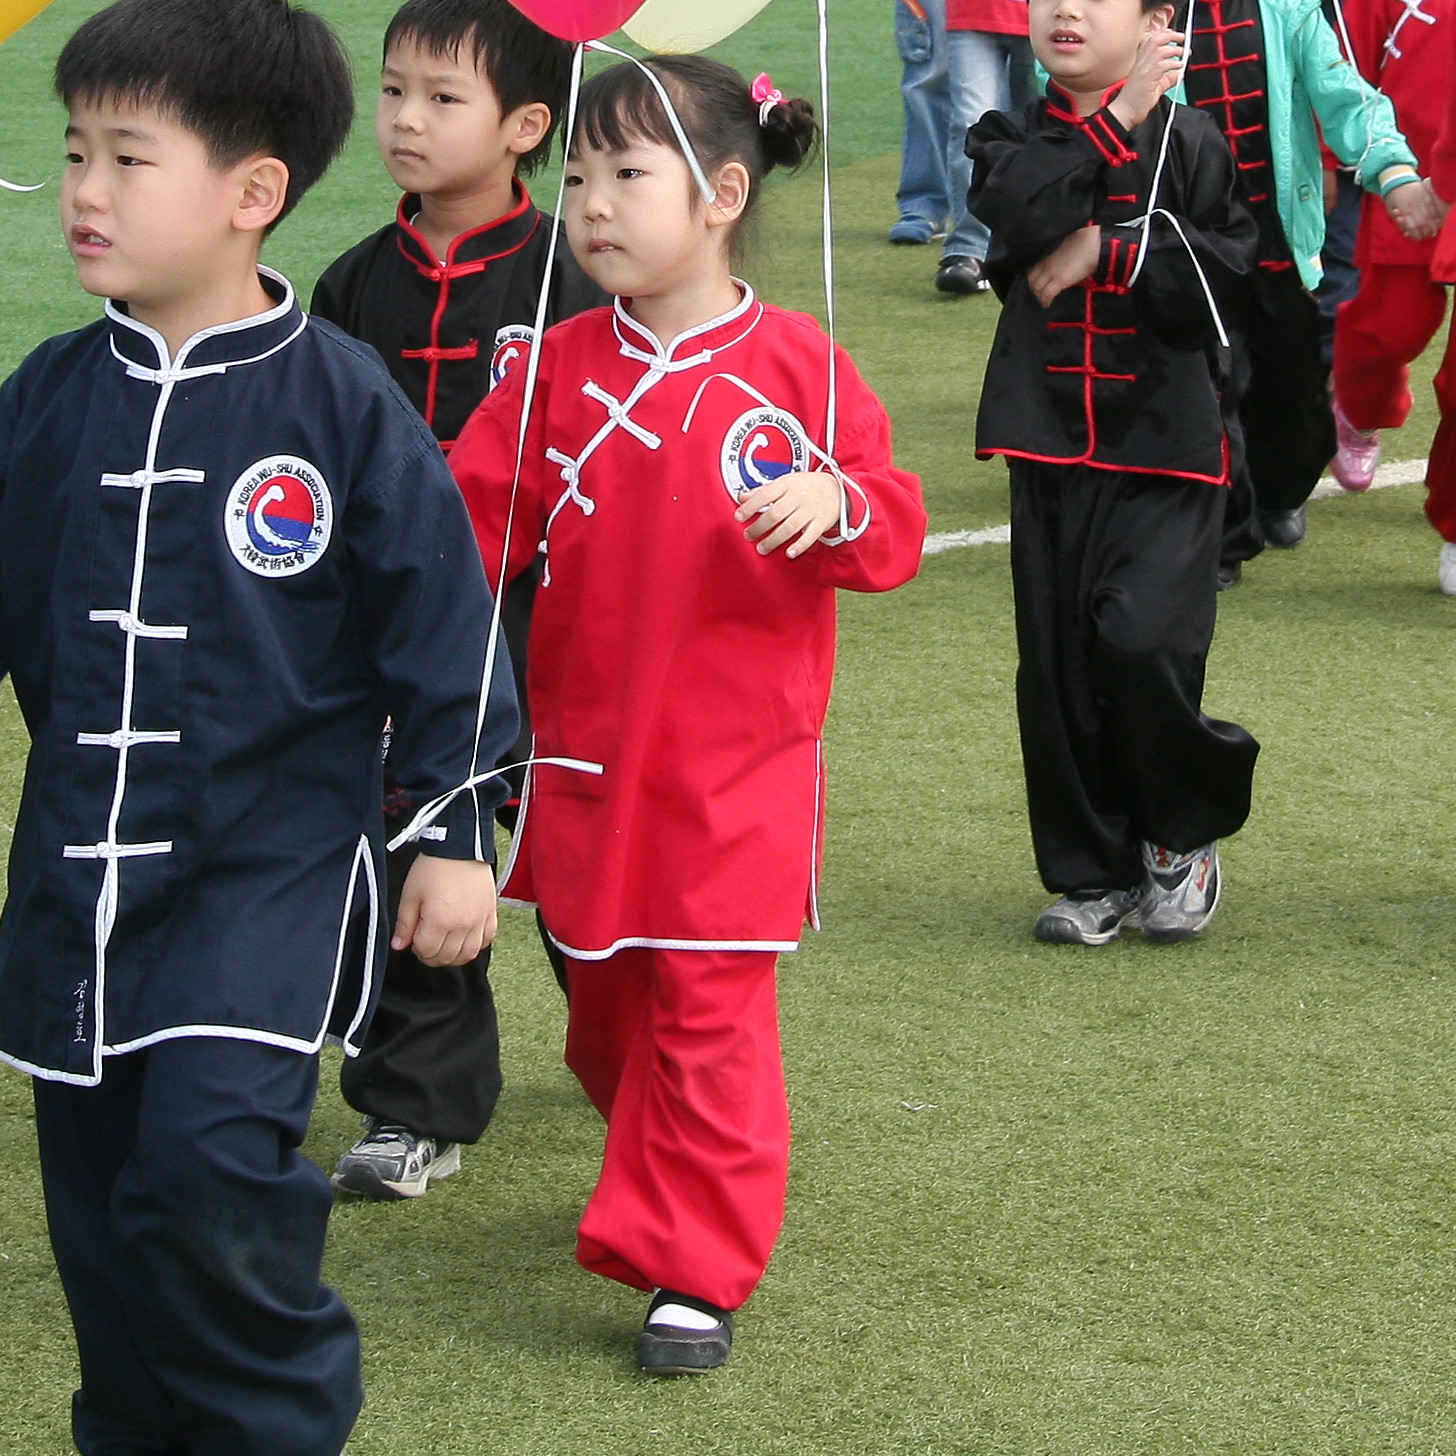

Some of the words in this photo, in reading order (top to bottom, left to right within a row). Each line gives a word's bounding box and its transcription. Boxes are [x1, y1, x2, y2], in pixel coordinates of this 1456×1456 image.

[237, 477, 261, 507] KOREA
[255, 462, 294, 482] WU-SHU
[292, 466, 326, 521] ASSOCIATION
